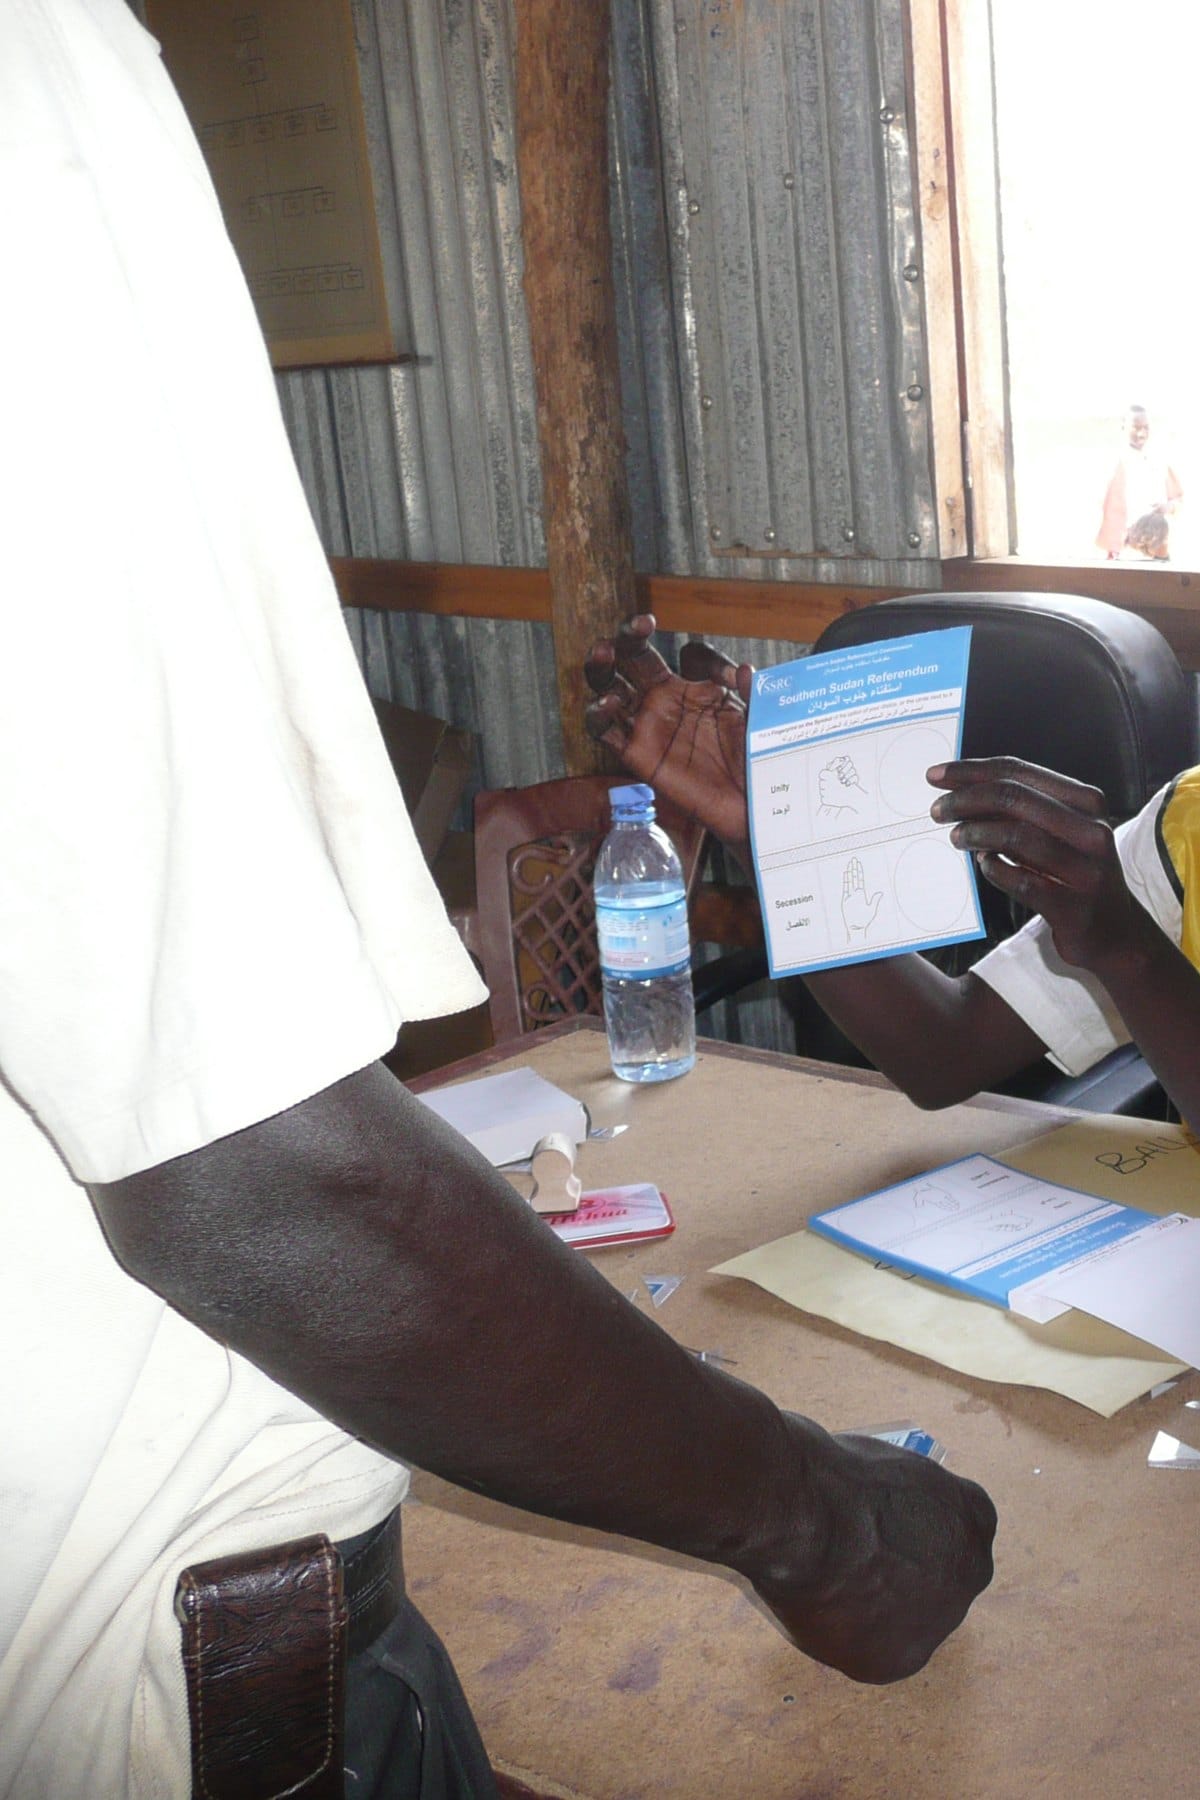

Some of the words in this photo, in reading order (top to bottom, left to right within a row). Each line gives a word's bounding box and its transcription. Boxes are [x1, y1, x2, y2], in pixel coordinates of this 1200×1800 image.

[763, 676, 793, 693] SSRC
[778, 687, 826, 706] Southern
[829, 679, 864, 694] Sudan
[867, 663, 938, 685] Referendum
[770, 783, 790, 794] Unity
[775, 894, 814, 909] Secession
